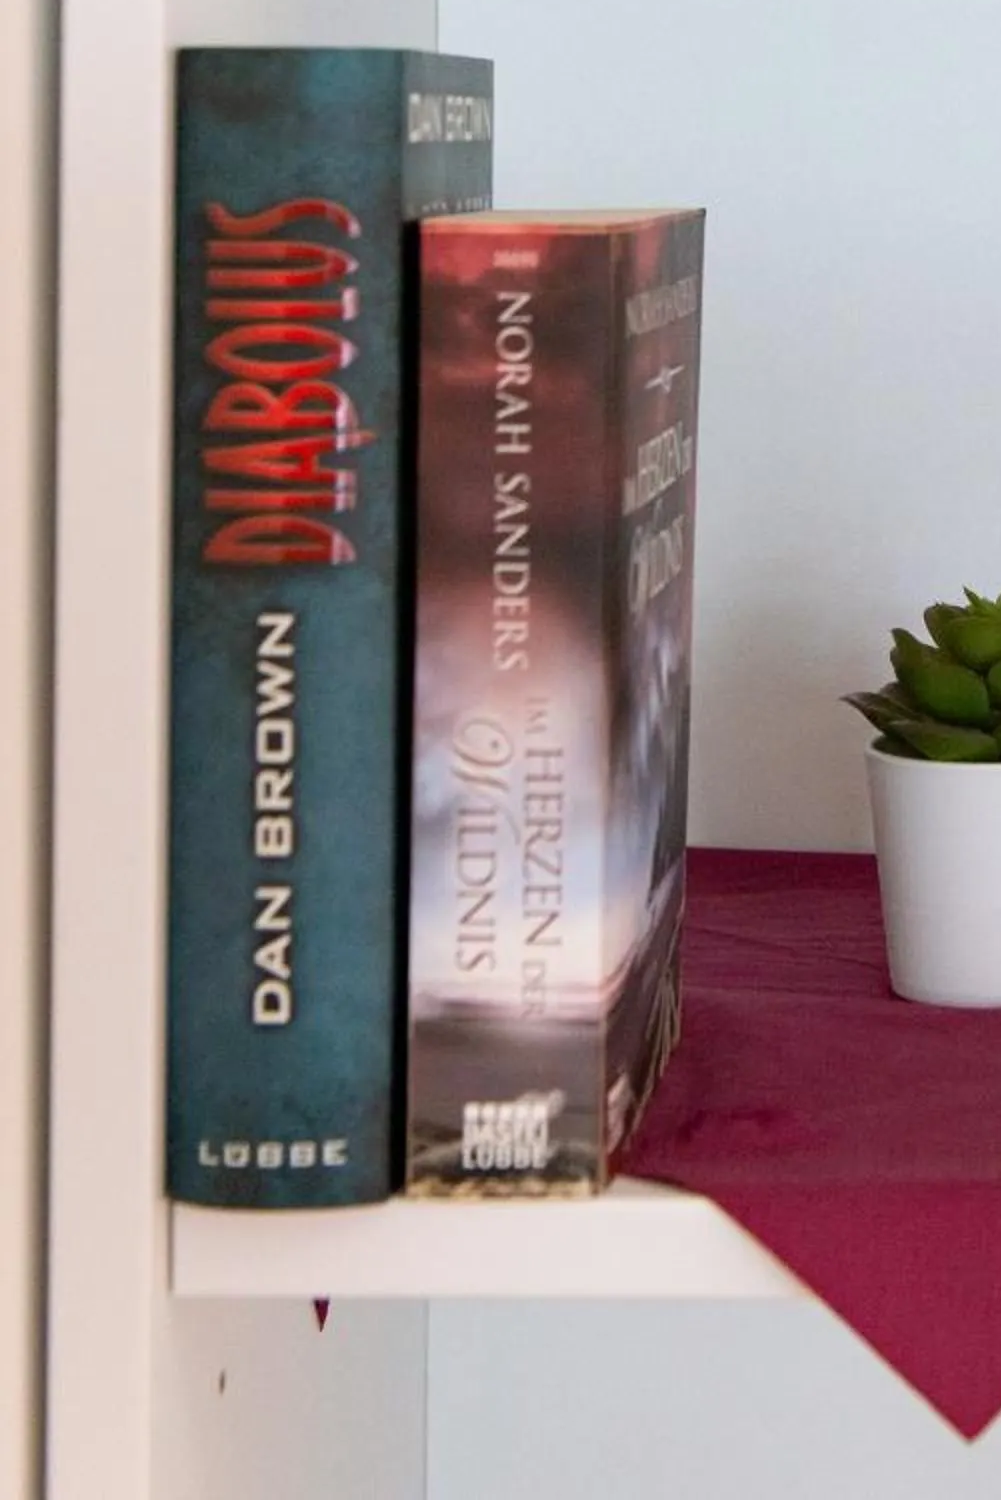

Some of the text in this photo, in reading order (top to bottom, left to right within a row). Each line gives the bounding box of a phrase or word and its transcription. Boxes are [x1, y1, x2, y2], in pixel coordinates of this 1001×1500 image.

[203, 197, 376, 563] DIABOLUS
[494, 291, 534, 454] NORAH
[493, 473, 532, 672] SANDERS
[253, 613, 295, 1025] DAN BROWN
[451, 717, 520, 973] WILDNIS
[522, 748, 562, 946] HERZEN
